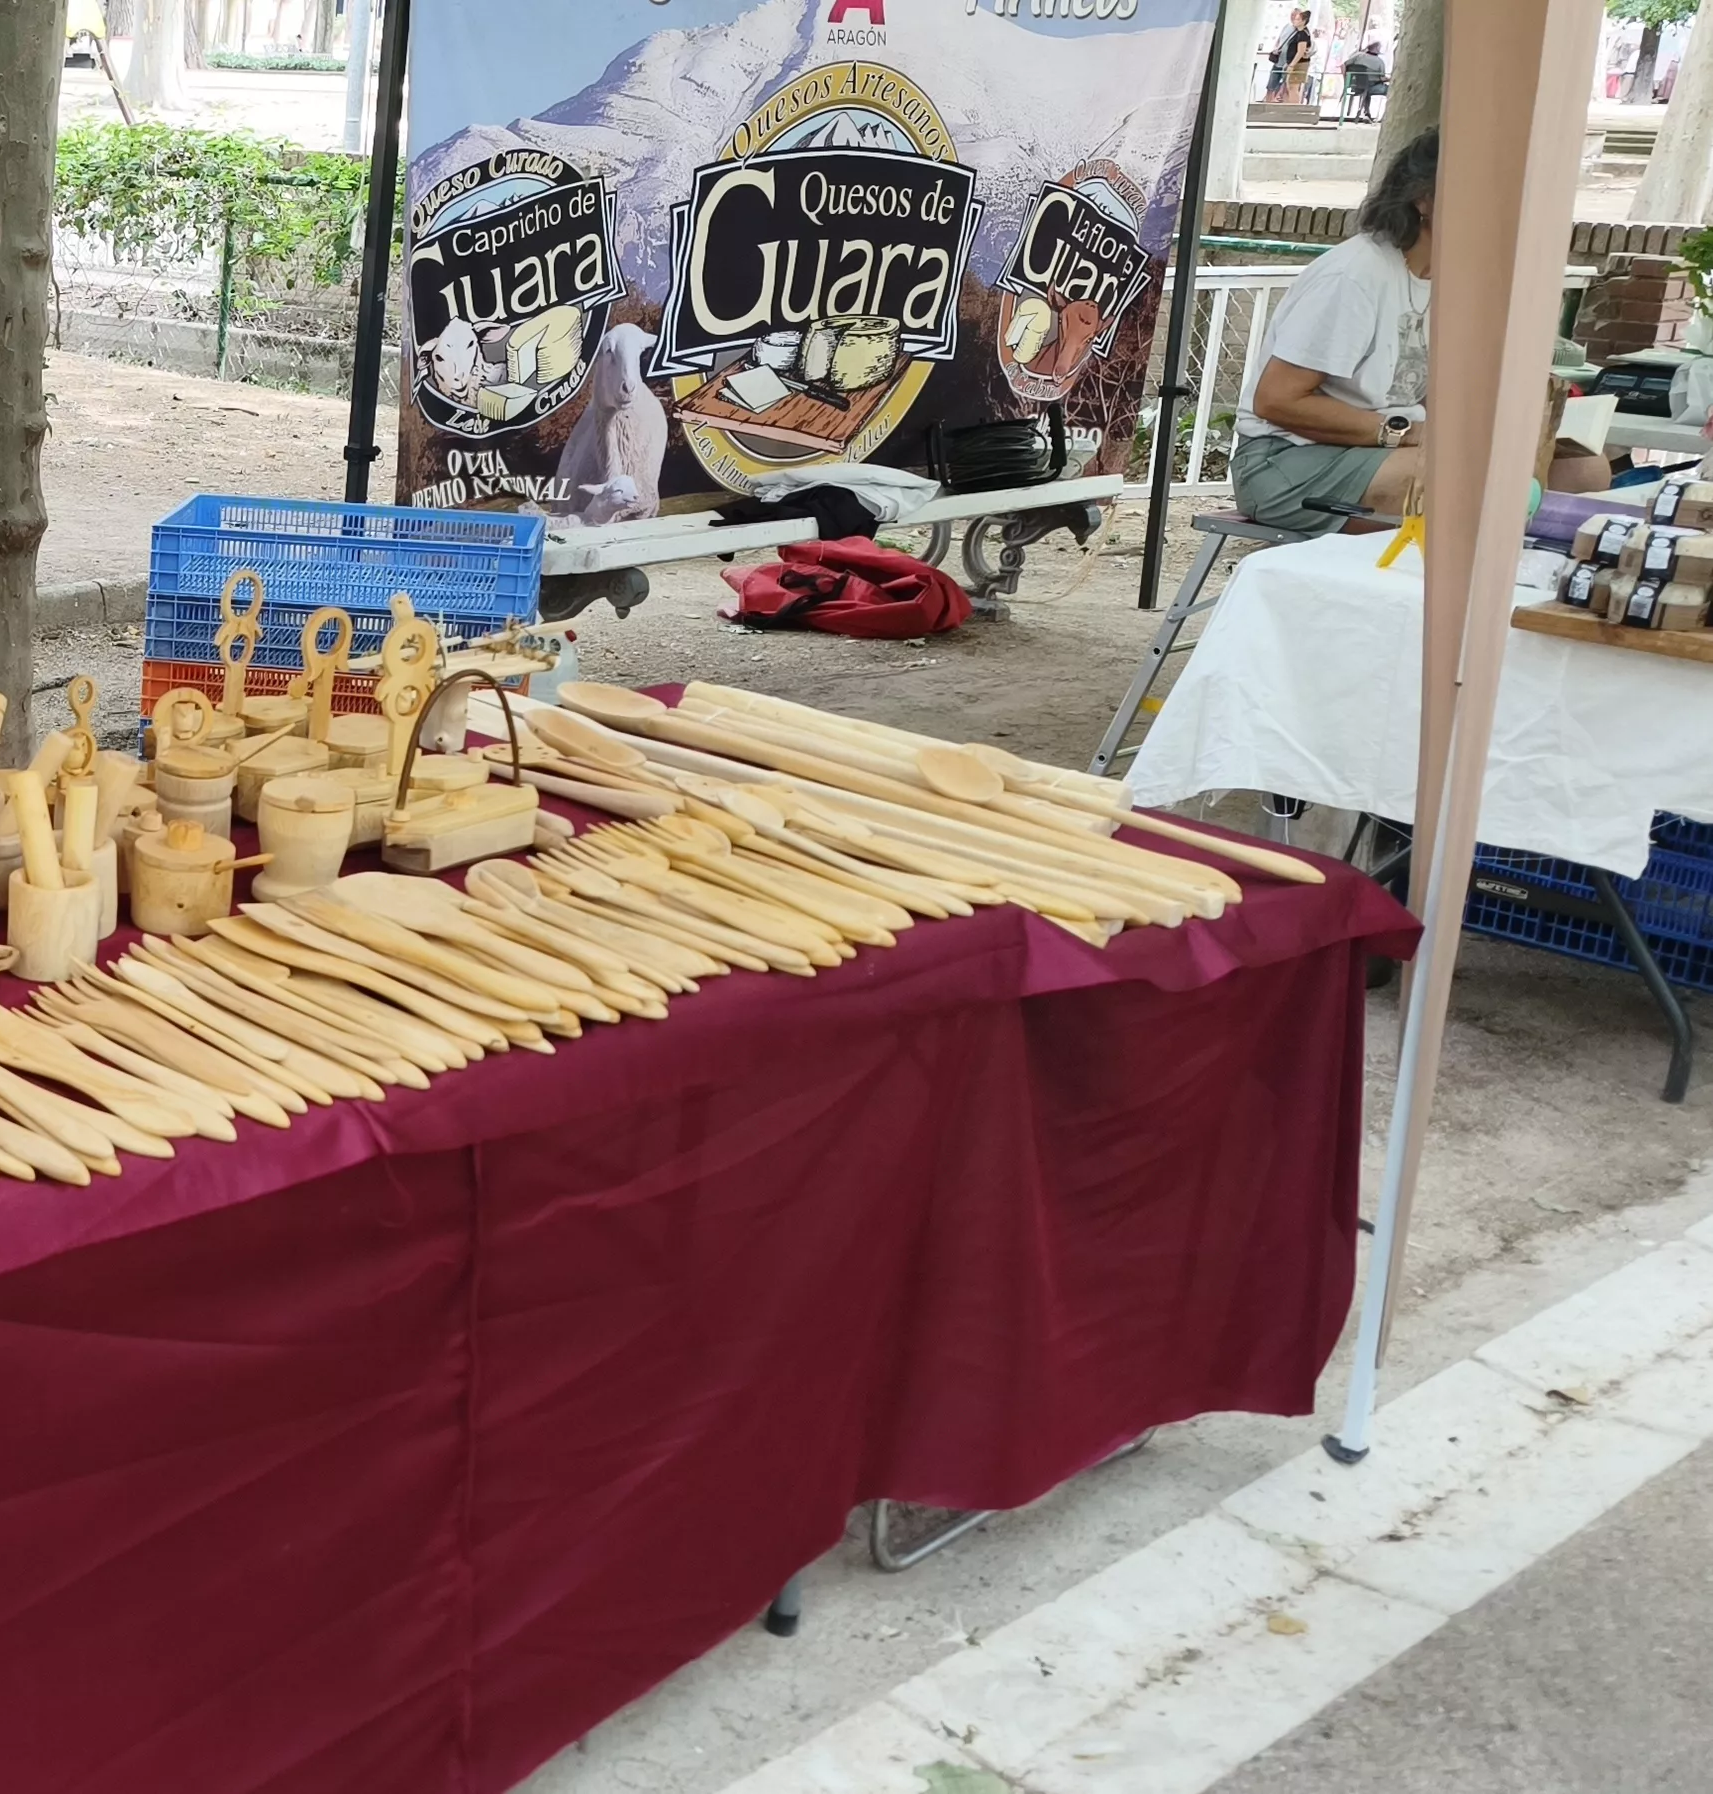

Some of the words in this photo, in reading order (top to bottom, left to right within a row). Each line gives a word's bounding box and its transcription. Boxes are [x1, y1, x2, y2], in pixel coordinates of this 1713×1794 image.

[827, 28, 887, 47] ARAGÓN
[733, 73, 833, 168] Quesos
[840, 61, 949, 162] Artesanos
[411, 167, 481, 239] Queso
[488, 151, 564, 180] Curado
[452, 204, 561, 257] Capricho
[569, 189, 596, 219] de
[800, 171, 913, 226] Quesos
[921, 179, 955, 225] de
[690, 166, 950, 336] Guara
[692, 421, 717, 459] Las
[711, 454, 752, 490] Almu
